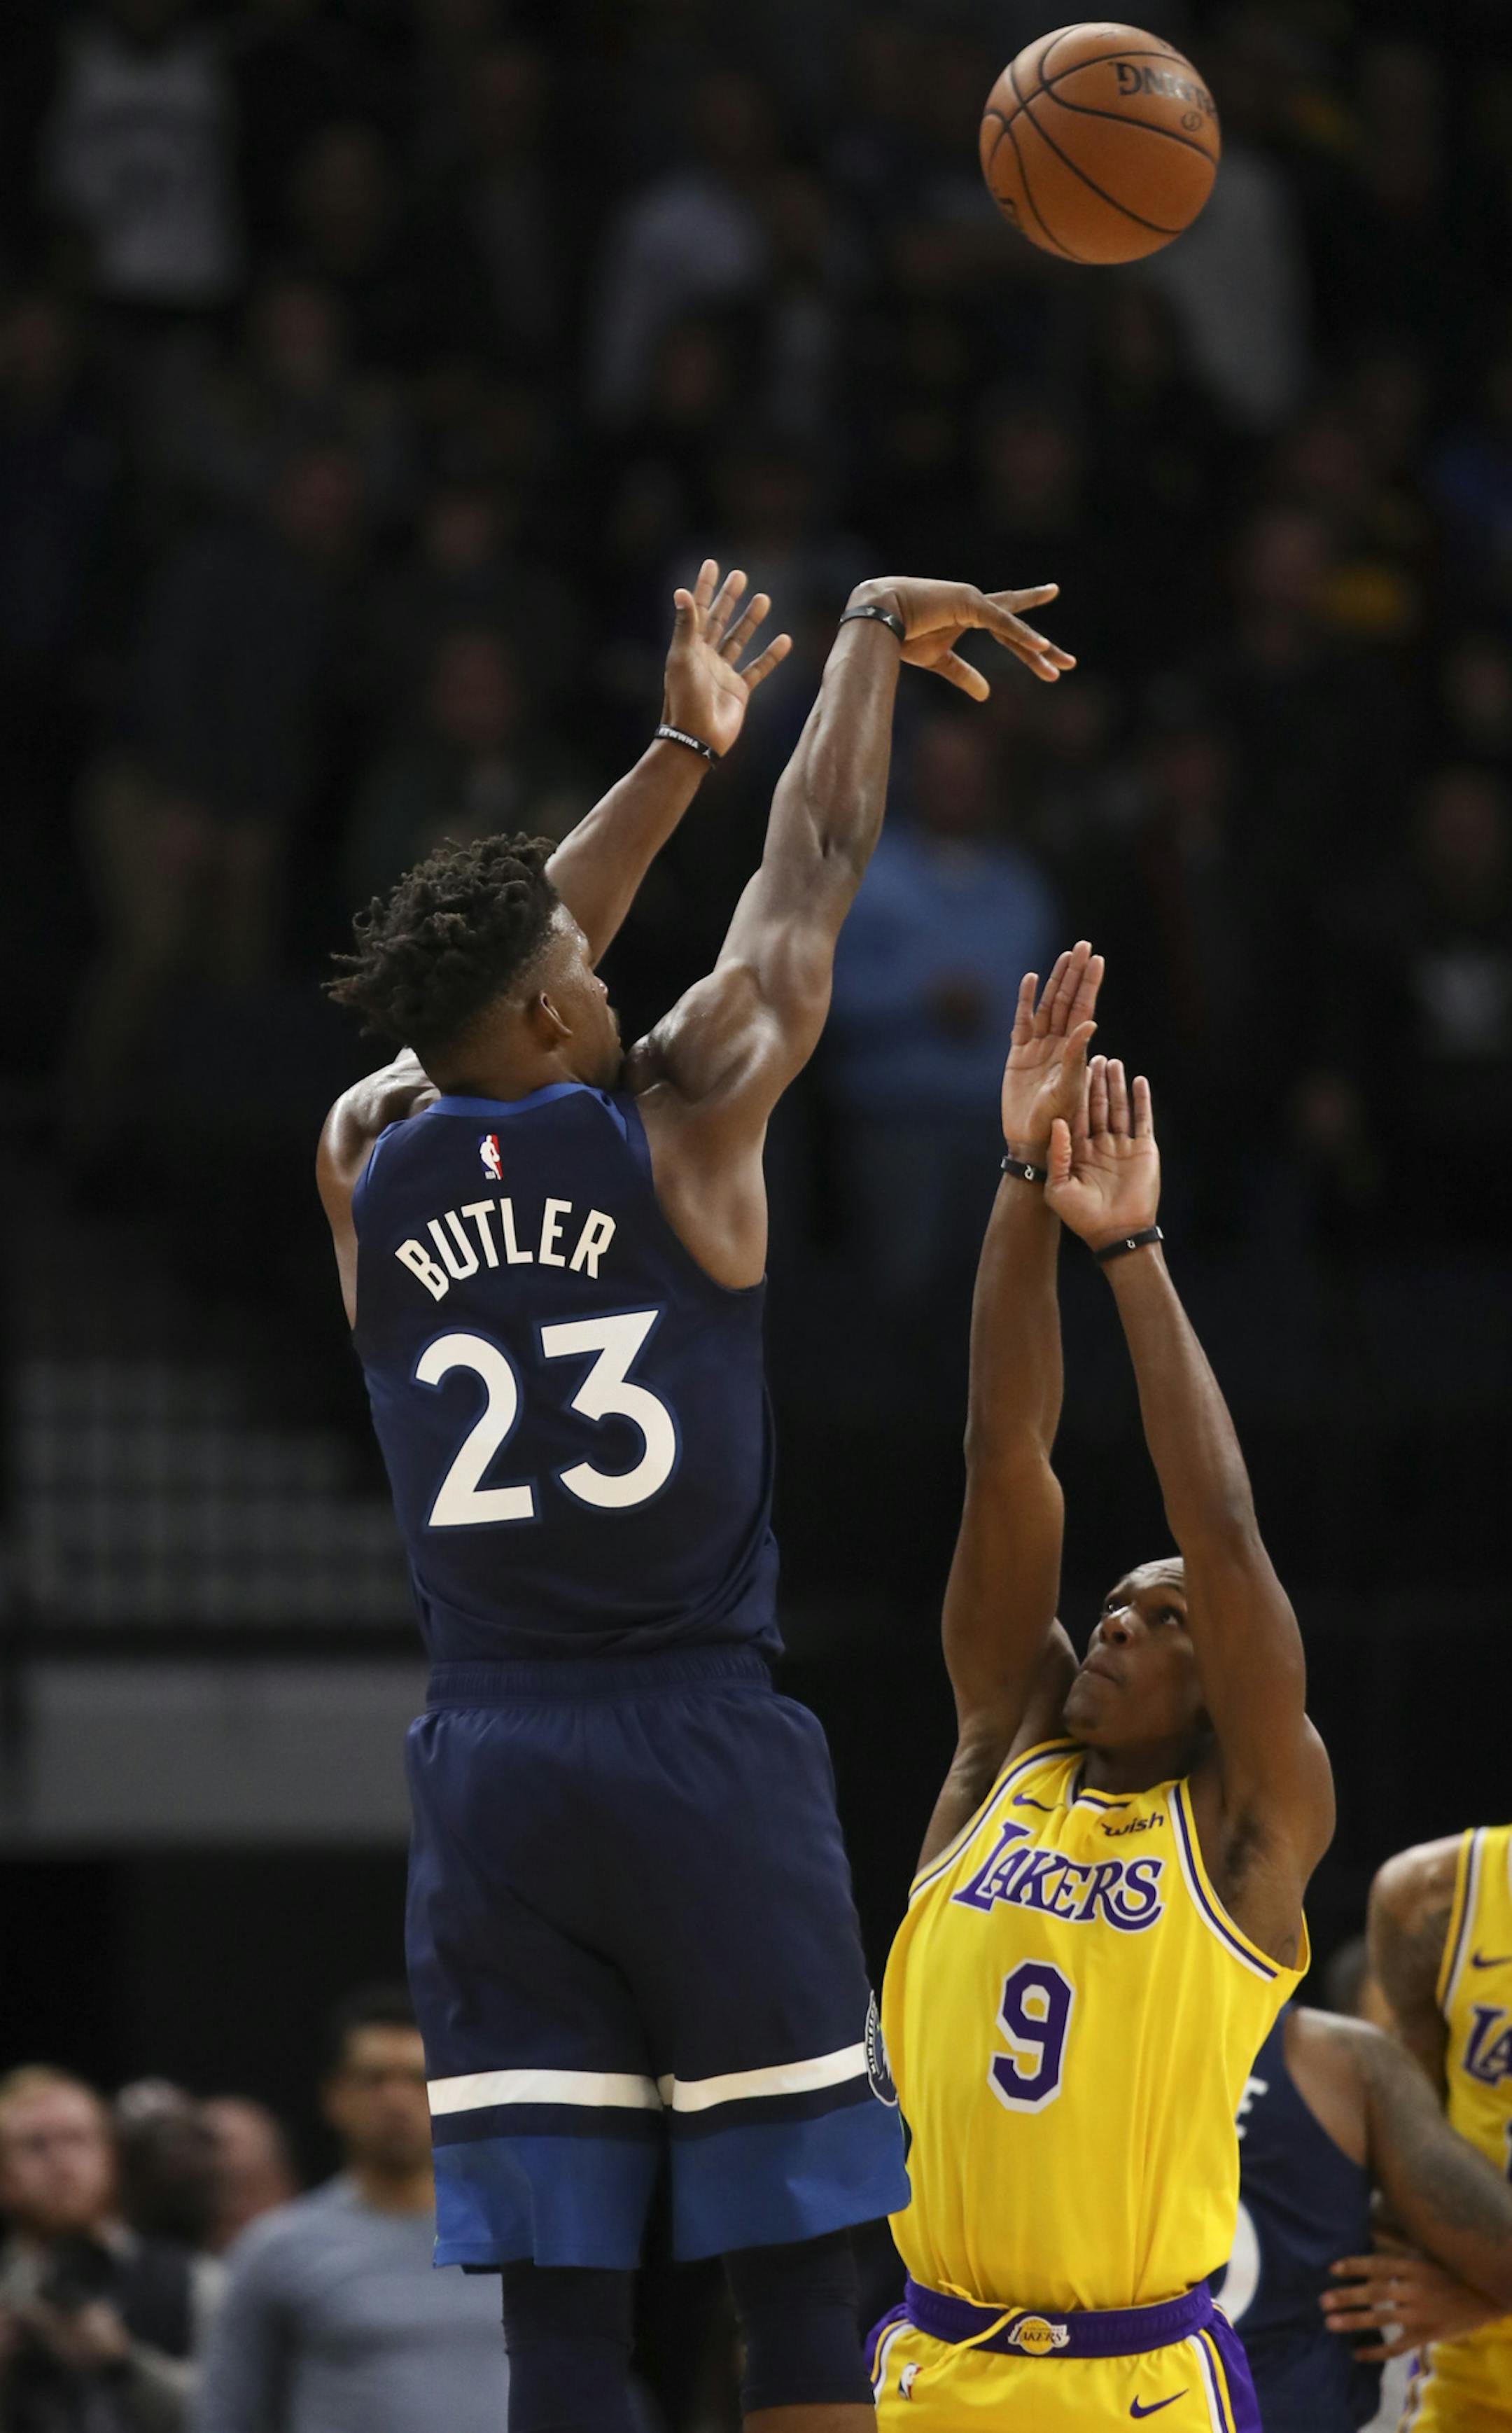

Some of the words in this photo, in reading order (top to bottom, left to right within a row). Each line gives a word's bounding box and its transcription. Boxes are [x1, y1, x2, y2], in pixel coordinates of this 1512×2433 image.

[395, 1197, 616, 1301] BUTLER
[414, 1309, 676, 1527] 23
[949, 1821, 1166, 1932] LAKERS
[1101, 1811, 1164, 1836] wish
[987, 1958, 1075, 2114] 9
